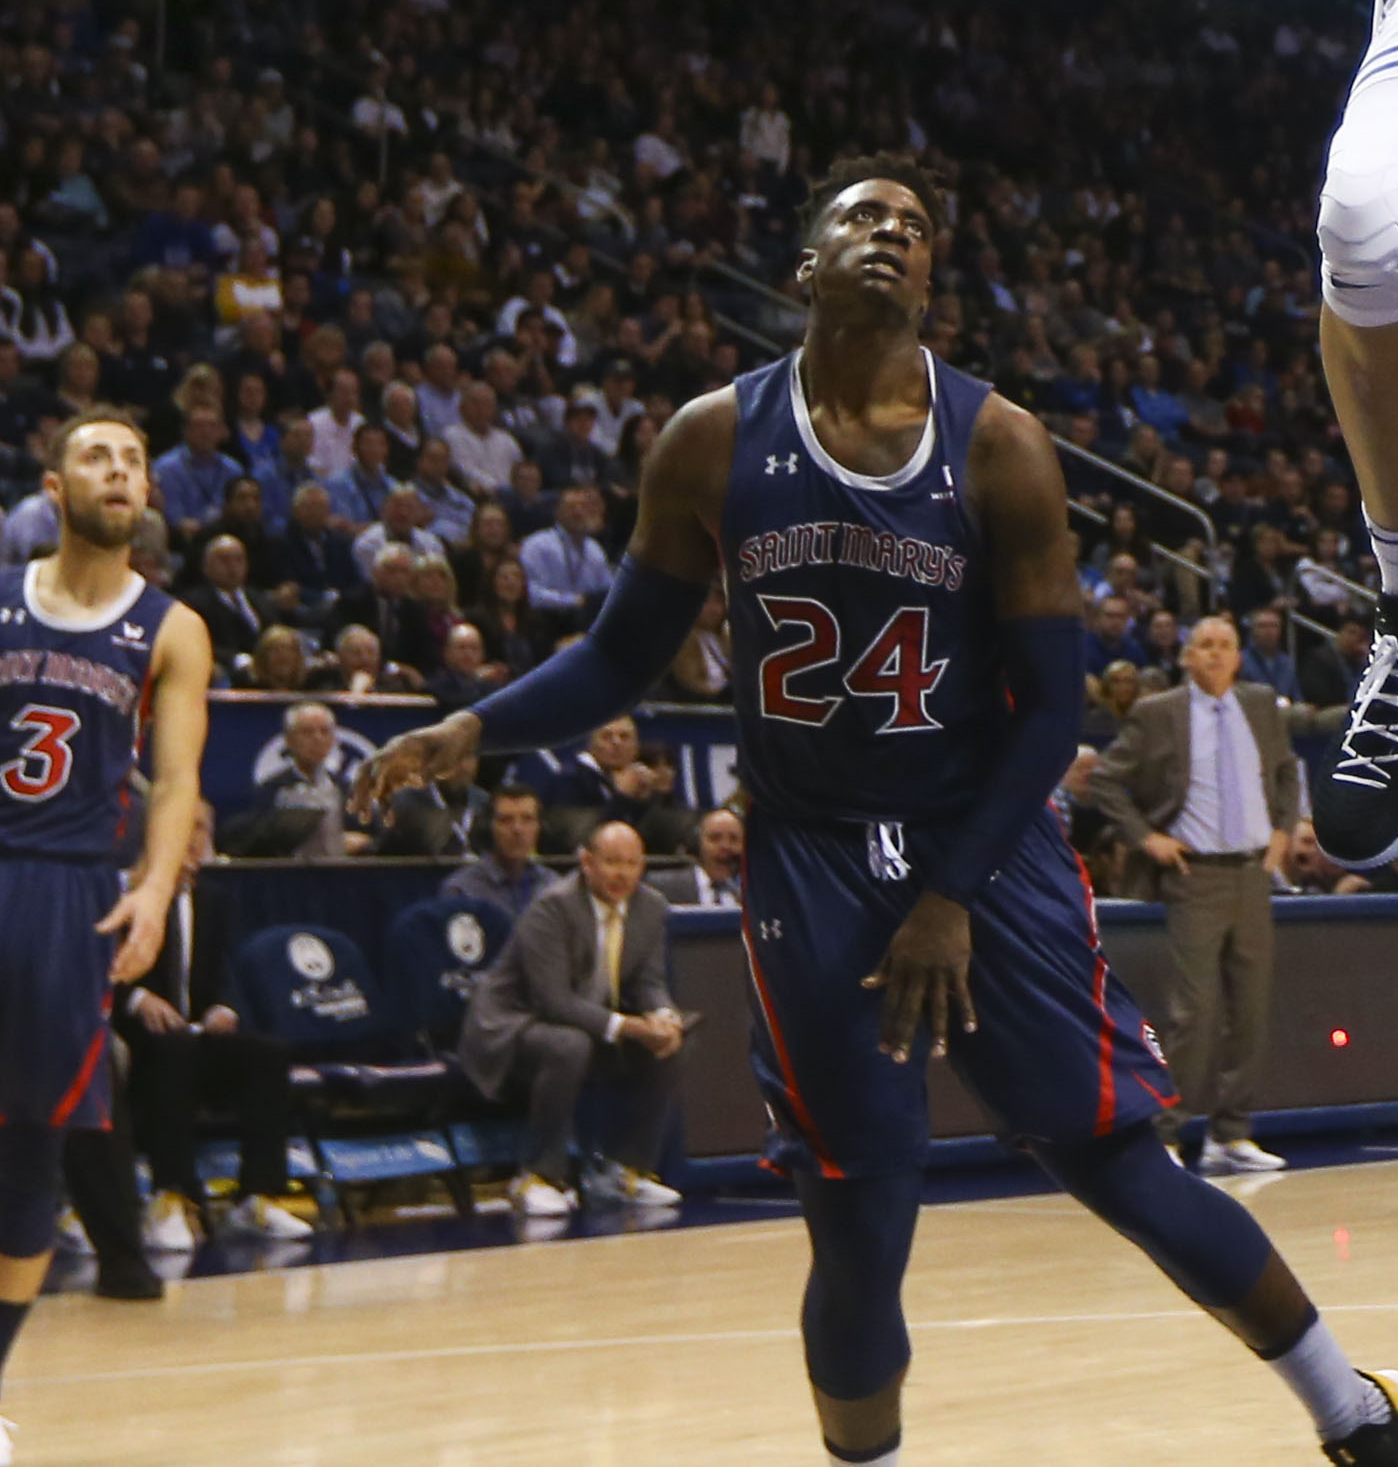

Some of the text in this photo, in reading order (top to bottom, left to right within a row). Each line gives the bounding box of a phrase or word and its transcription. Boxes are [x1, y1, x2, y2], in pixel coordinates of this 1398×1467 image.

[739, 521, 967, 591] SAINT MARY'S
[757, 593, 950, 735] 24
[1, 703, 81, 804] 3
